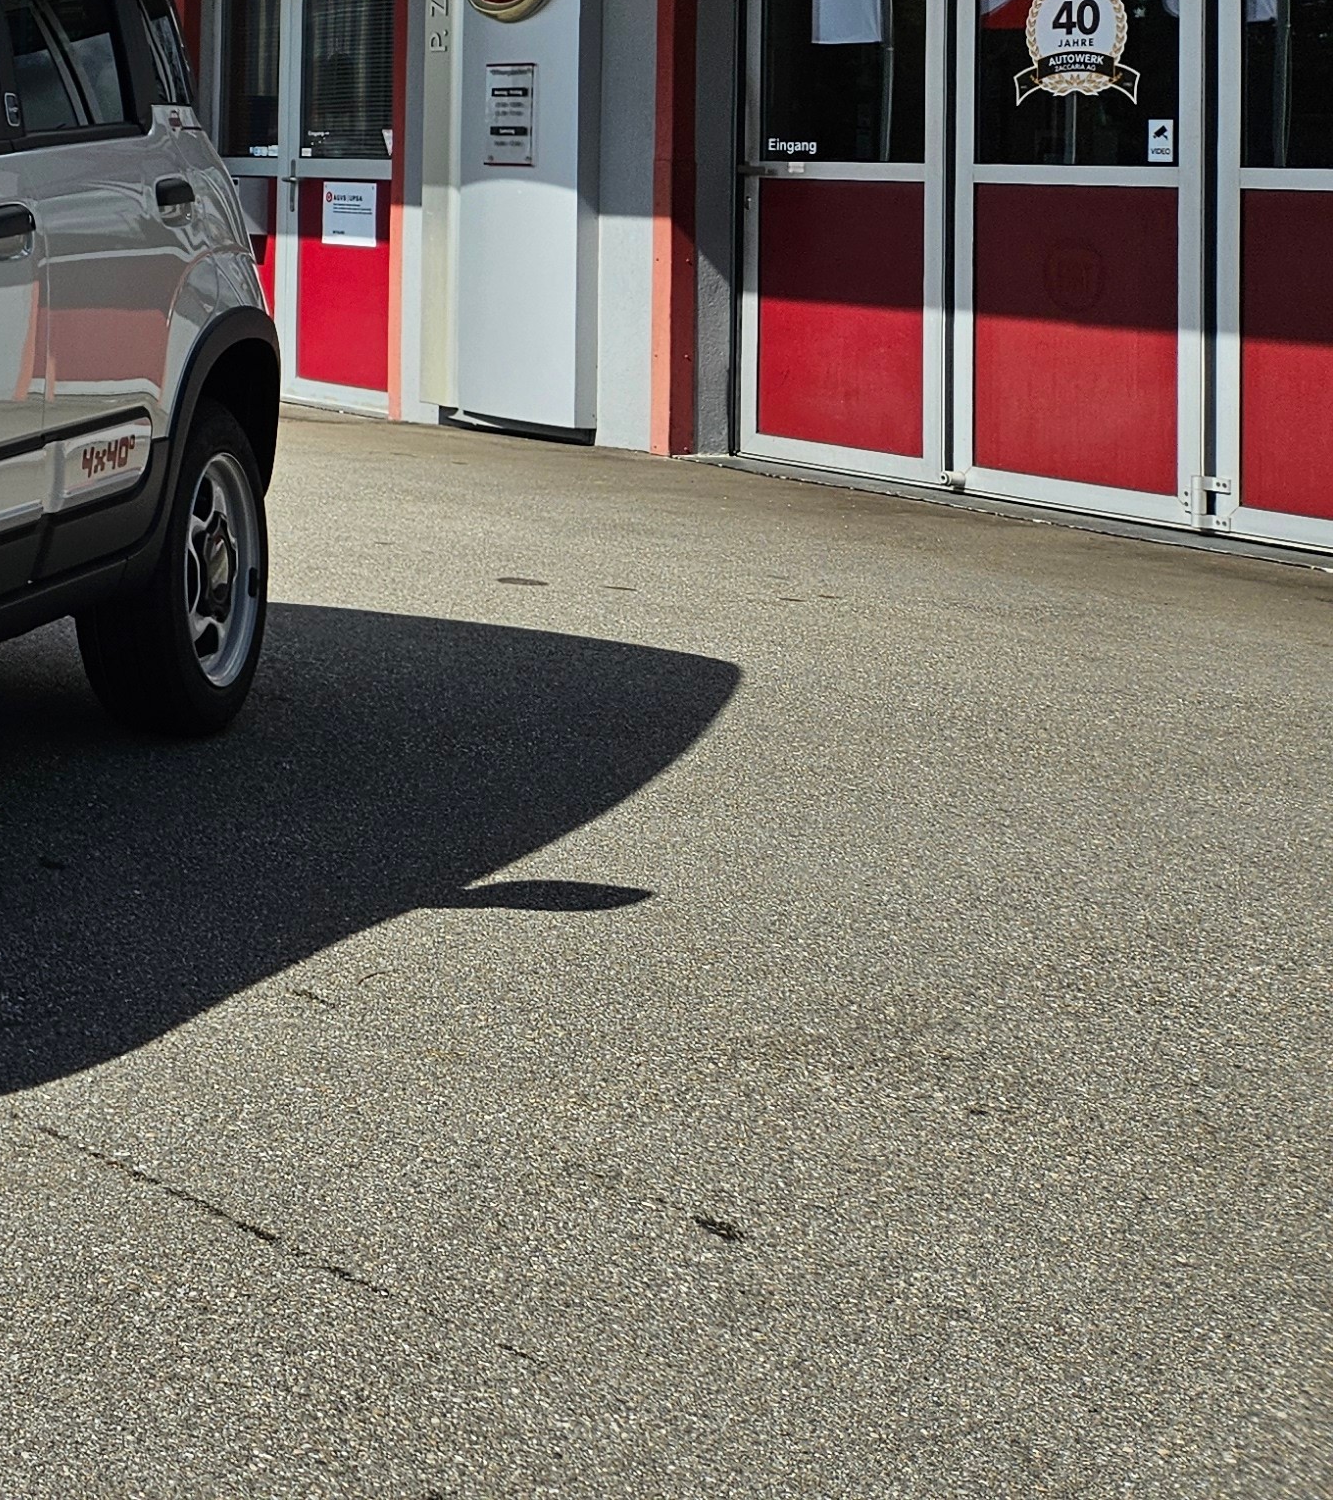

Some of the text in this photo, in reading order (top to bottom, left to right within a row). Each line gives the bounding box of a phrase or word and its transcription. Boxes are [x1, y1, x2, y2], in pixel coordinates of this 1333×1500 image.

[430, 30, 448, 53] P.
[1058, 38, 1094, 48] JAHRE
[1048, 53, 1105, 67] AUTOWERK
[1054, 63, 1096, 72] ZACCARIA AG
[767, 137, 817, 155] Eingang
[1150, 147, 1171, 155] VIDEO
